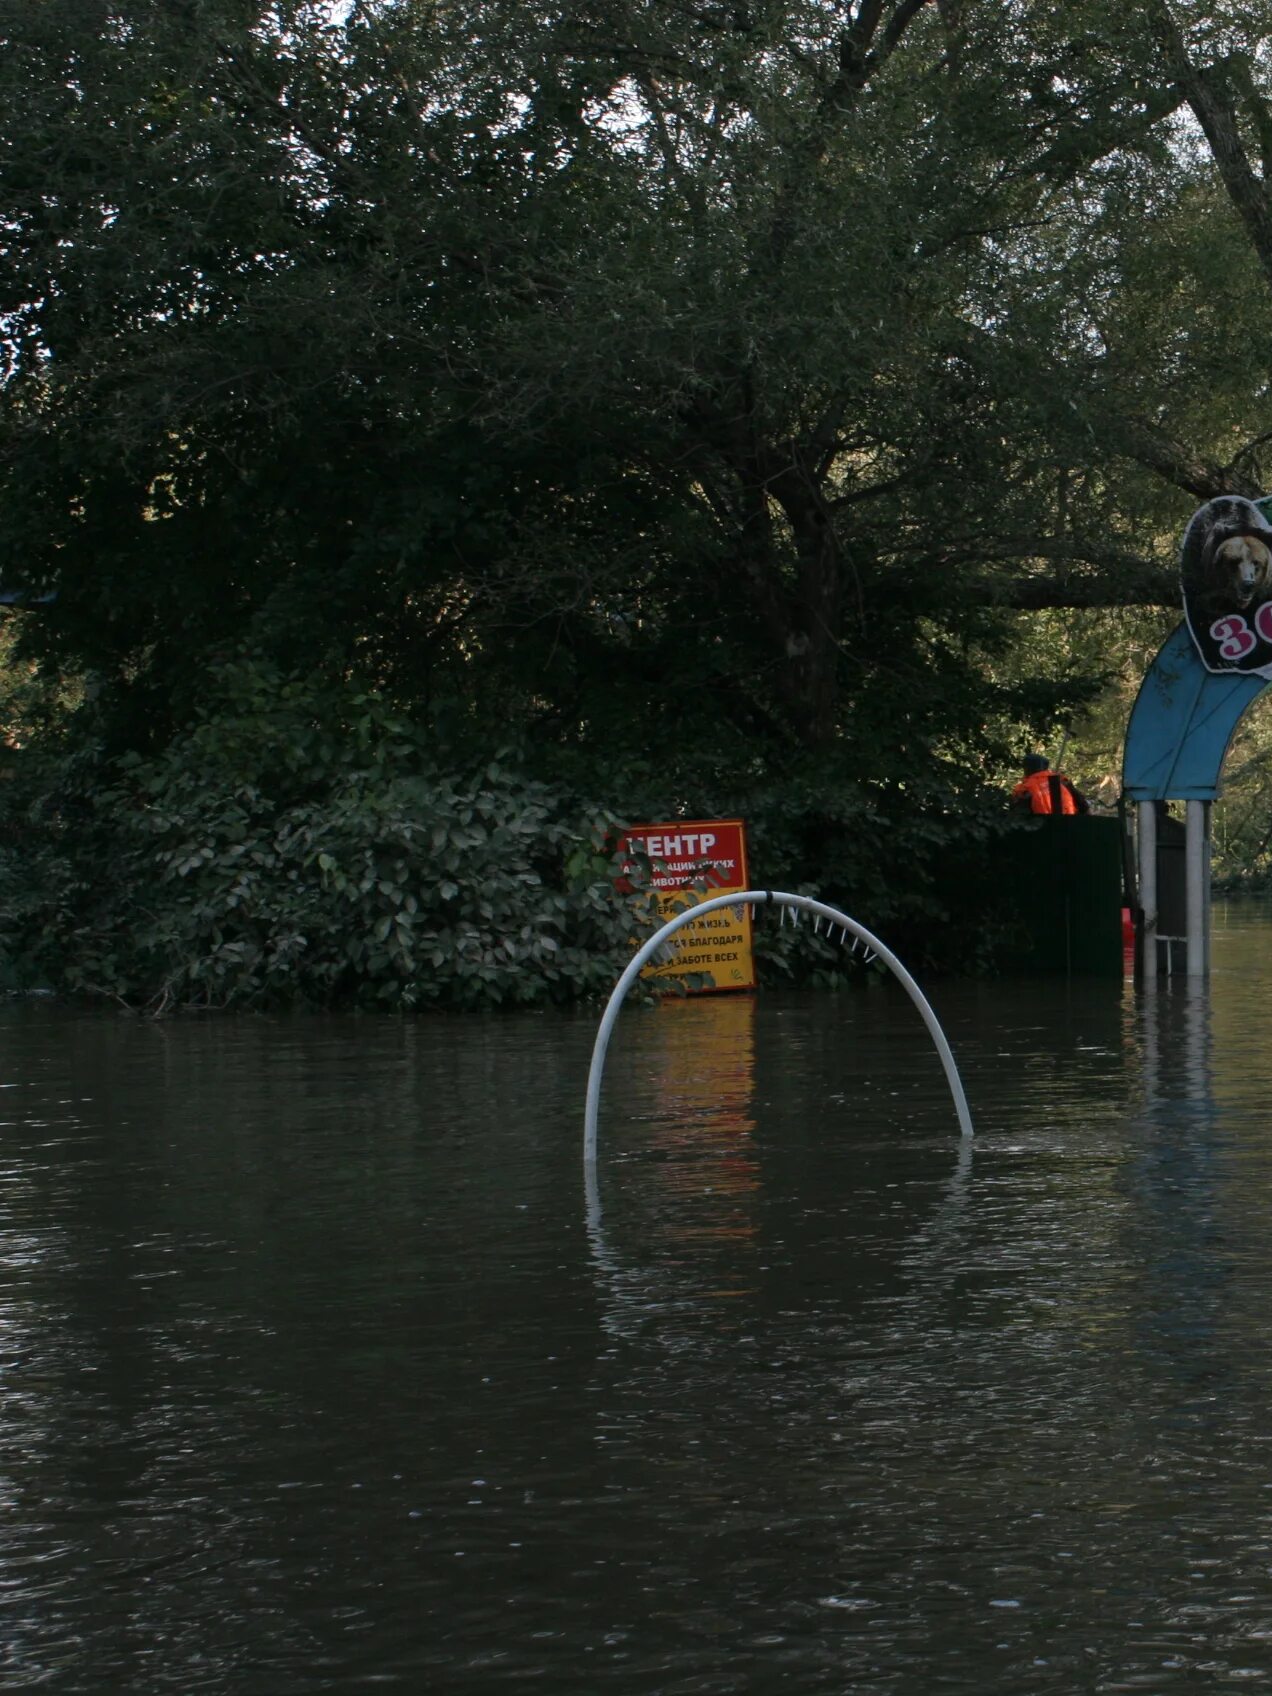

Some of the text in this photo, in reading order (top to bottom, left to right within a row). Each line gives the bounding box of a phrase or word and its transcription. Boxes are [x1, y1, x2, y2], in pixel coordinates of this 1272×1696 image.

[689, 935, 743, 947] БЛАГОДАРЯ
[676, 953, 713, 965] ЗАБОТЕ
[715, 951, 739, 963] ВСЕХ
